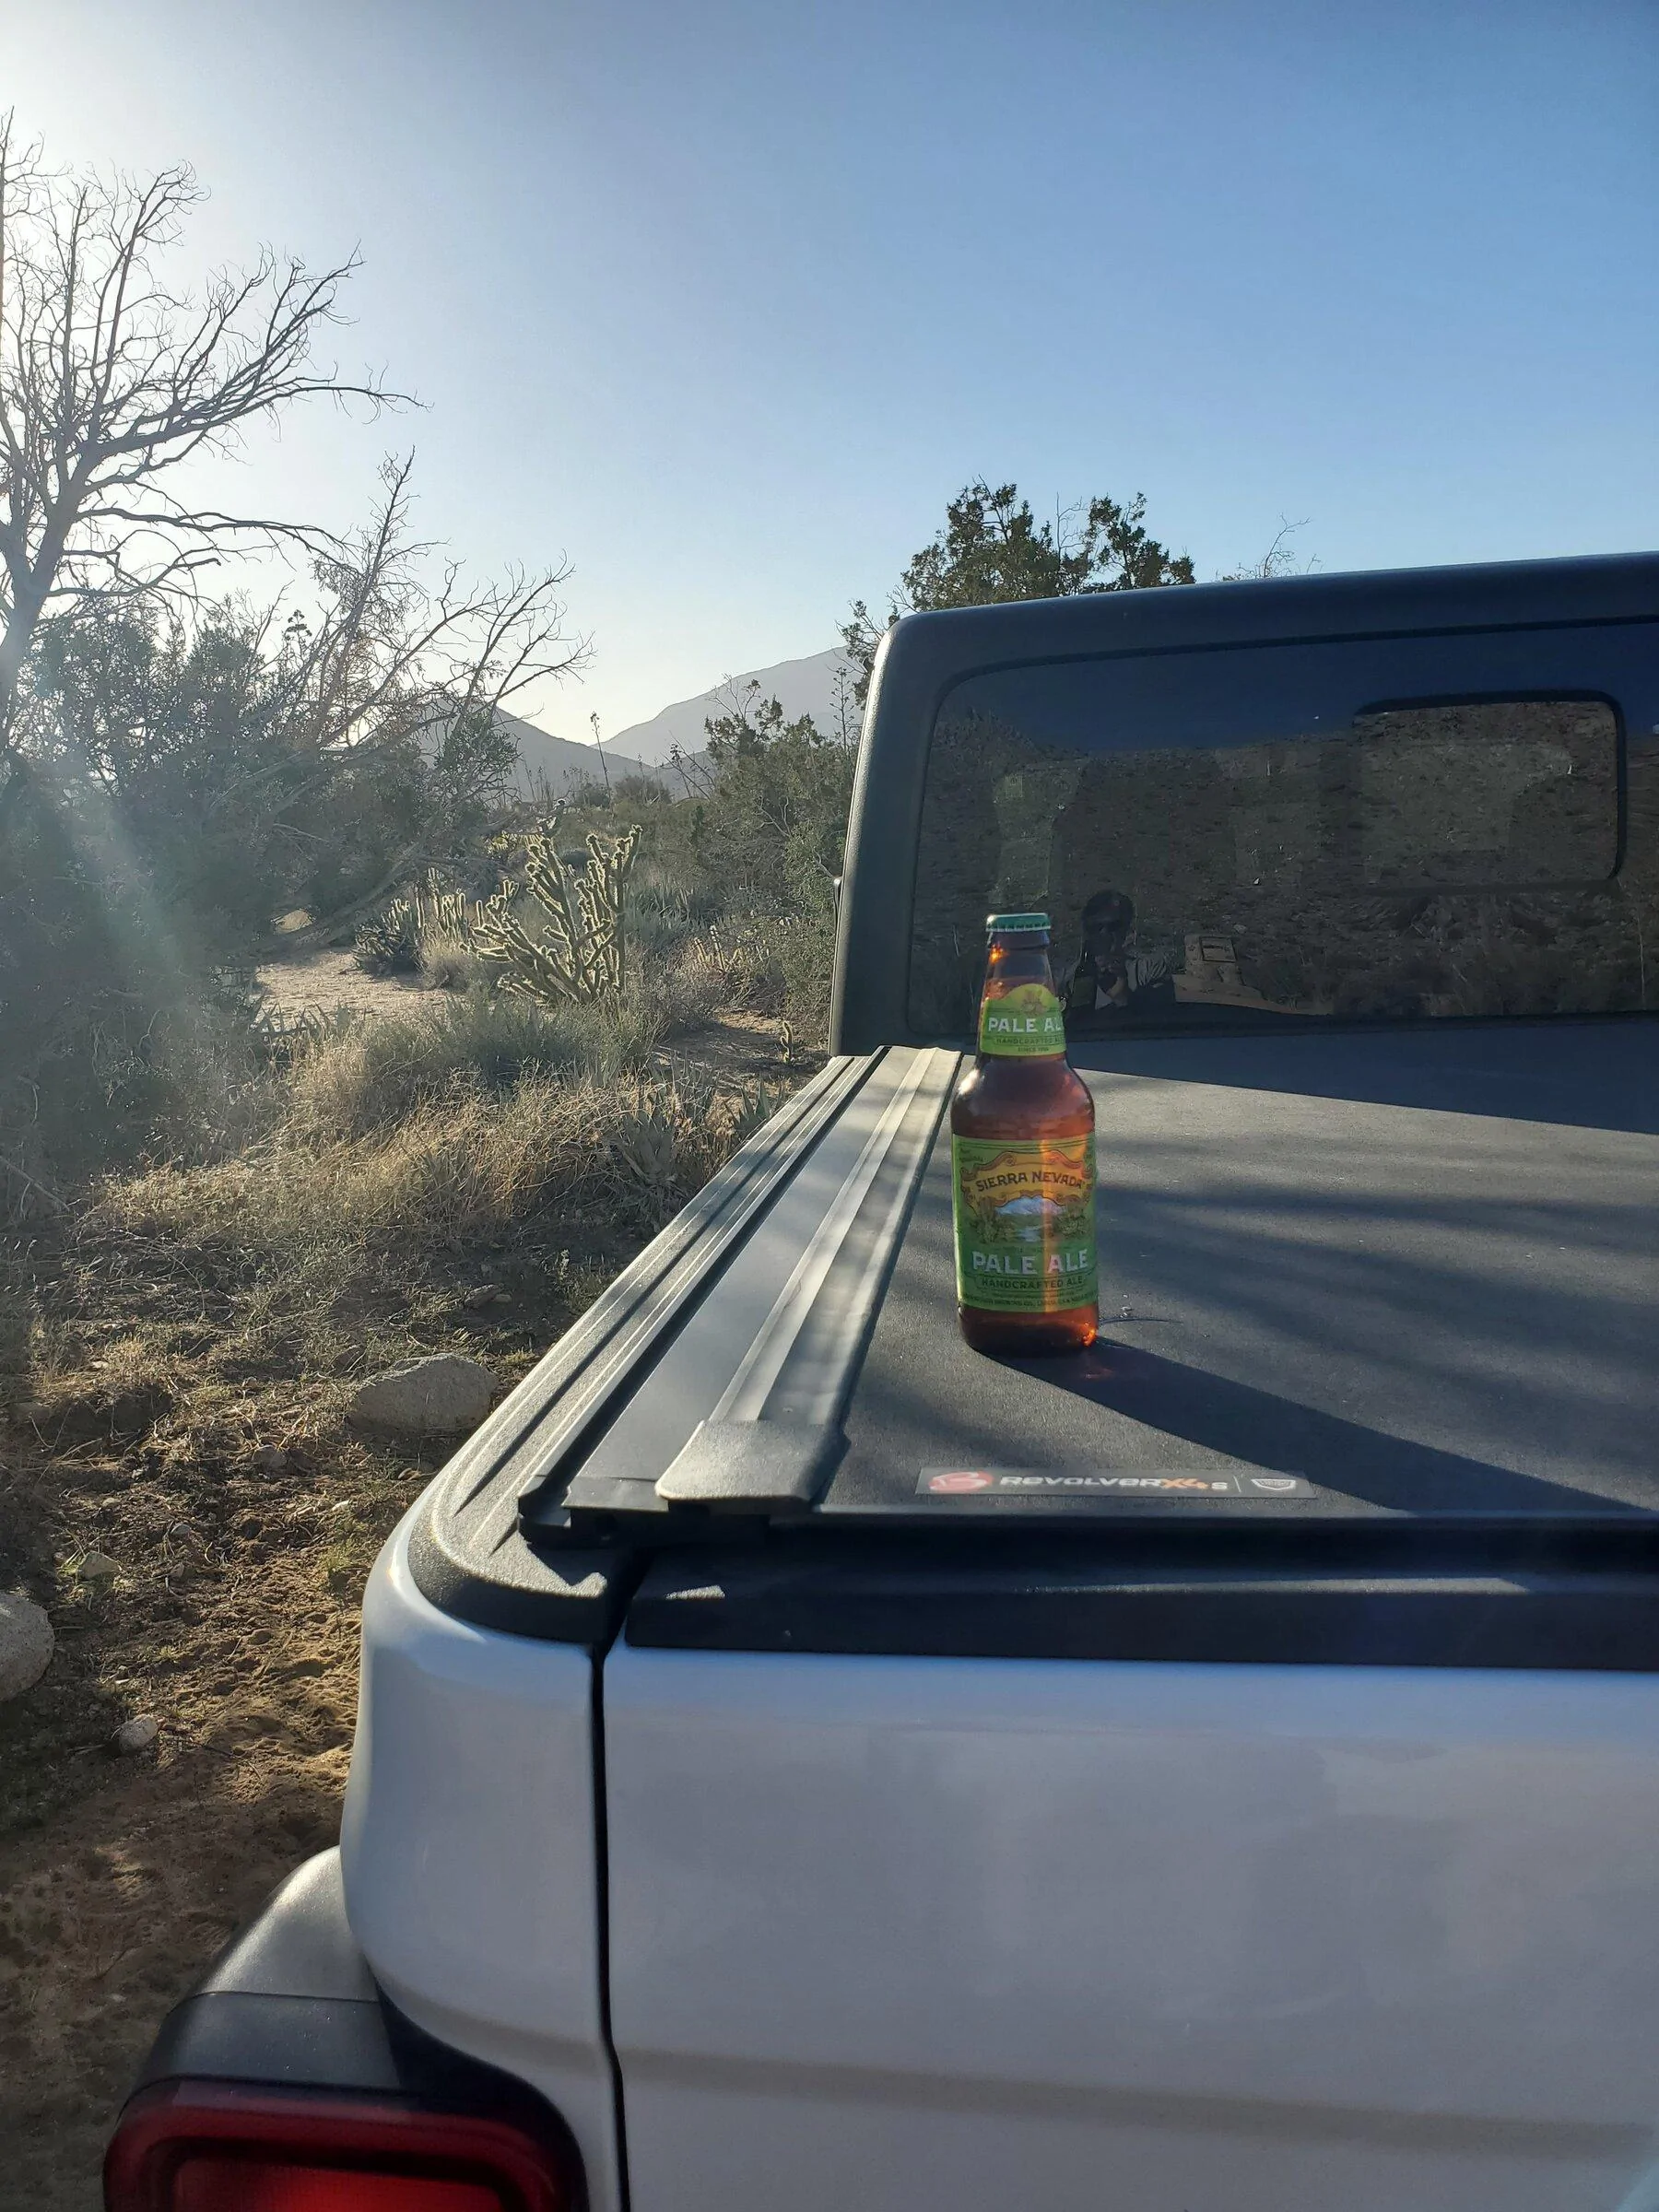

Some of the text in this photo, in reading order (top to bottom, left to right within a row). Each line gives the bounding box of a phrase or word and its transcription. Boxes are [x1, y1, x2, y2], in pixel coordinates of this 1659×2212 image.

[988, 1016, 1064, 1033] PALE AL
[975, 1171, 1082, 1193] SIERRA NEVADA
[971, 1248, 1088, 1275] PALE ALE
[982, 1275, 1084, 1289] HANDCRAFTED ALE
